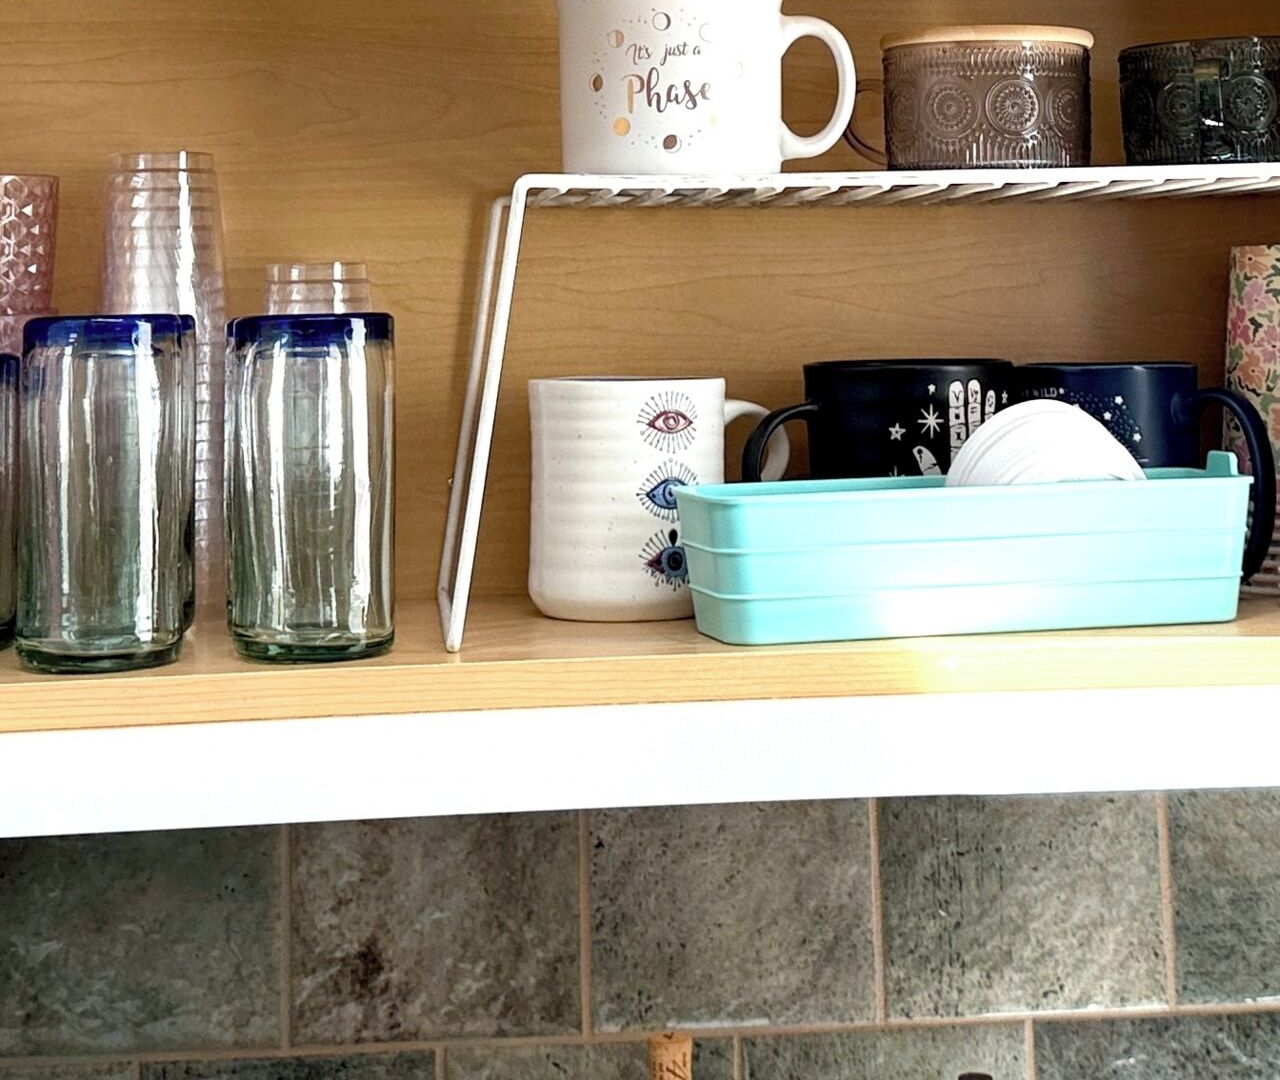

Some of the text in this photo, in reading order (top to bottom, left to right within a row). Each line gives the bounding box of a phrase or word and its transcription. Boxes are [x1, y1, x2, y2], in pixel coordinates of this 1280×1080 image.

[660, 41, 689, 66] just
[692, 45, 702, 56] a
[620, 66, 711, 115] Phase
